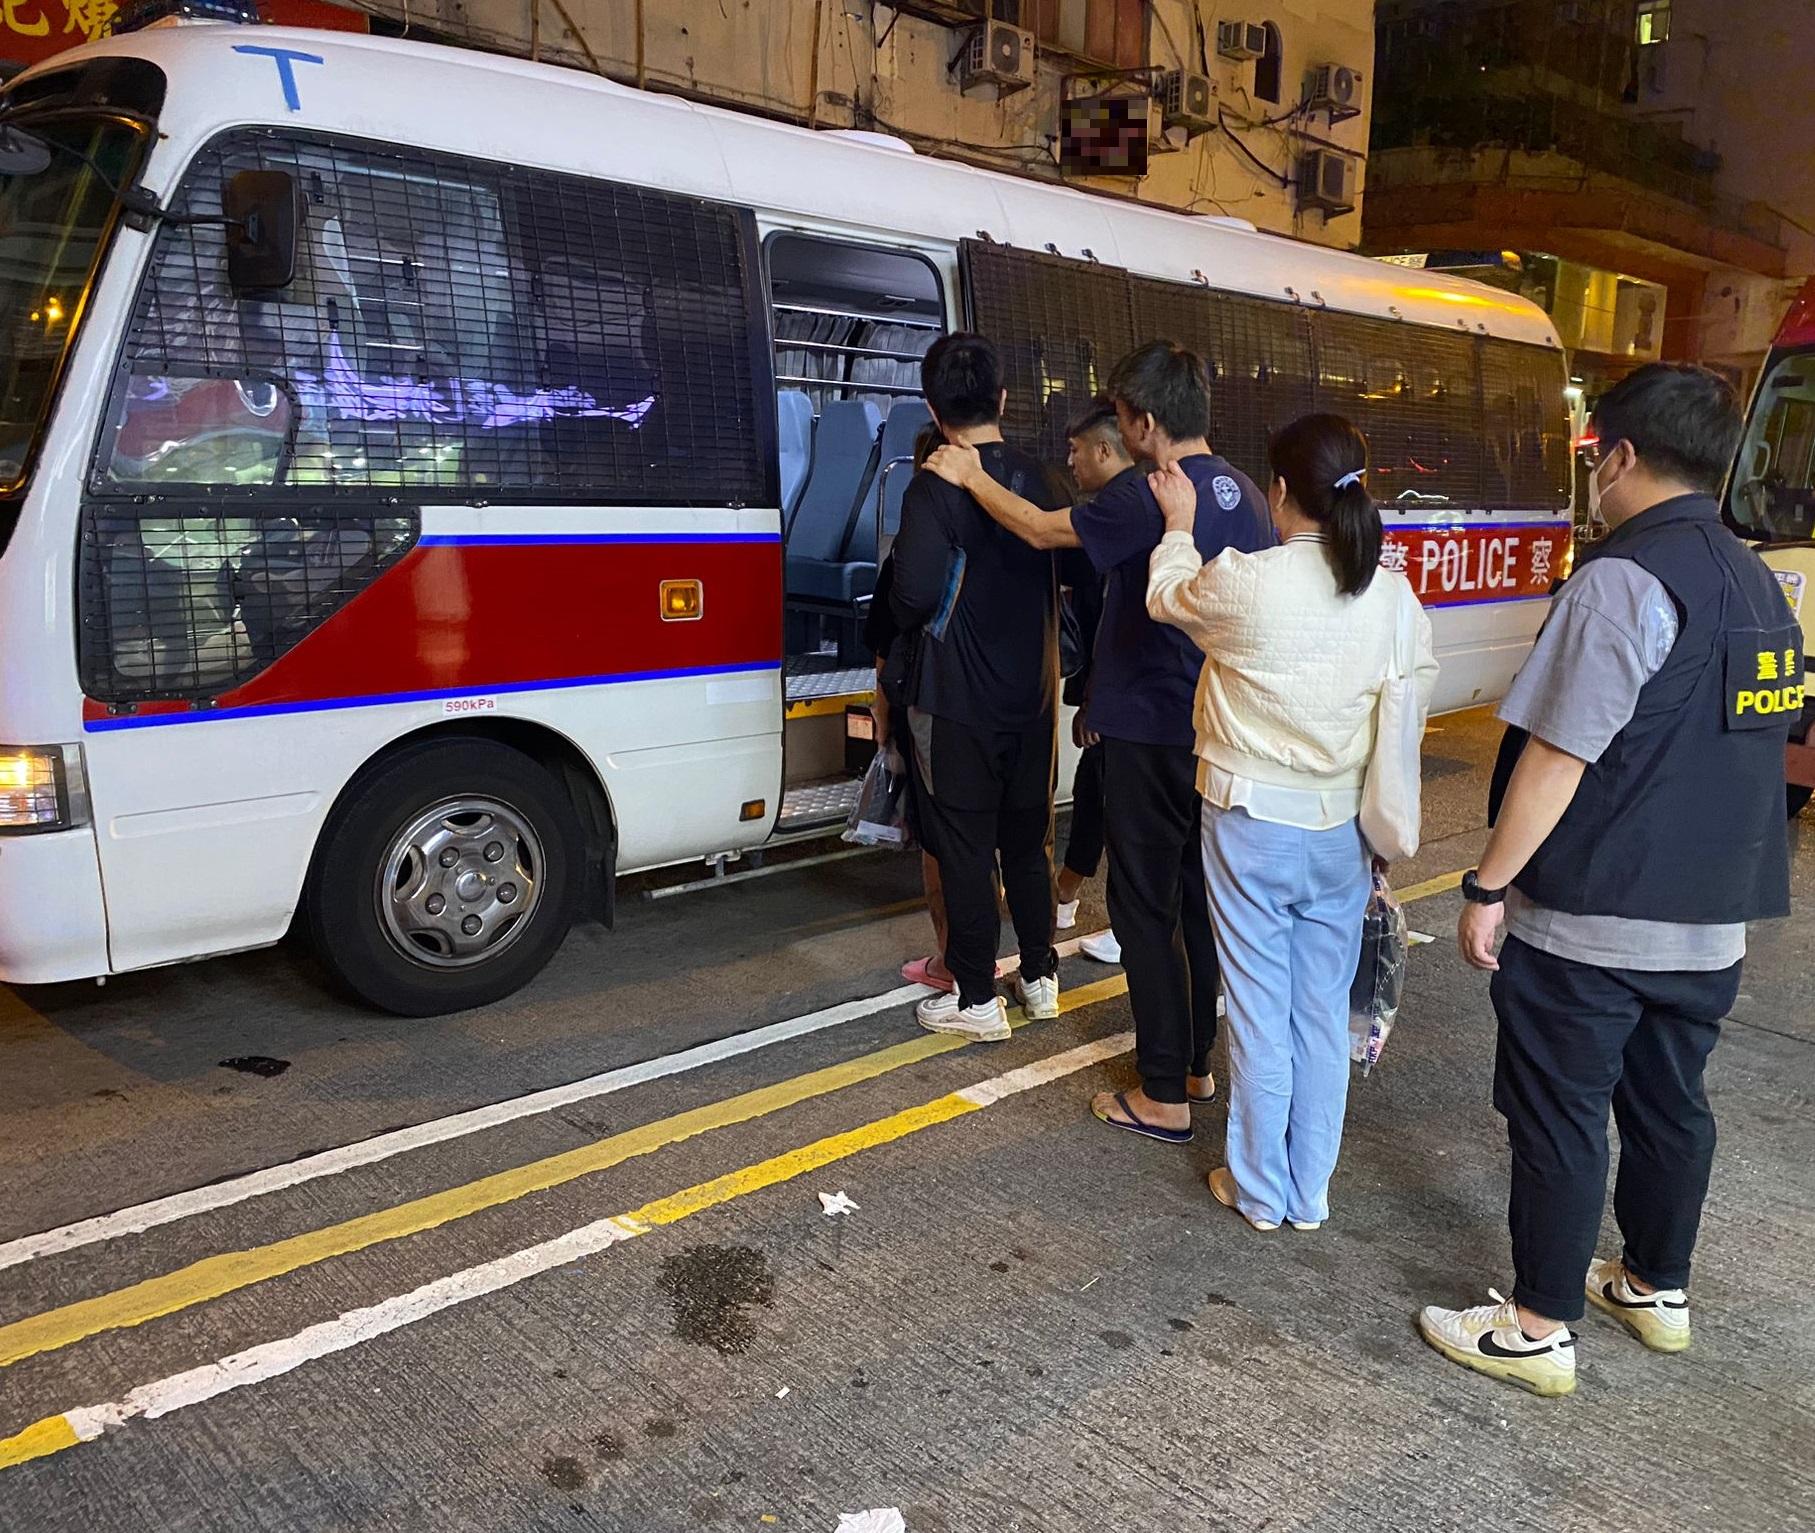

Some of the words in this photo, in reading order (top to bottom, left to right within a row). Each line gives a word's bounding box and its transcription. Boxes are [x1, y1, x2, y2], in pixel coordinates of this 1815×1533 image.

[230, 45, 324, 113] T
[1419, 537, 1520, 594] POLICE
[1530, 536, 1553, 585] 察
[445, 698, 494, 712] 590kPa
